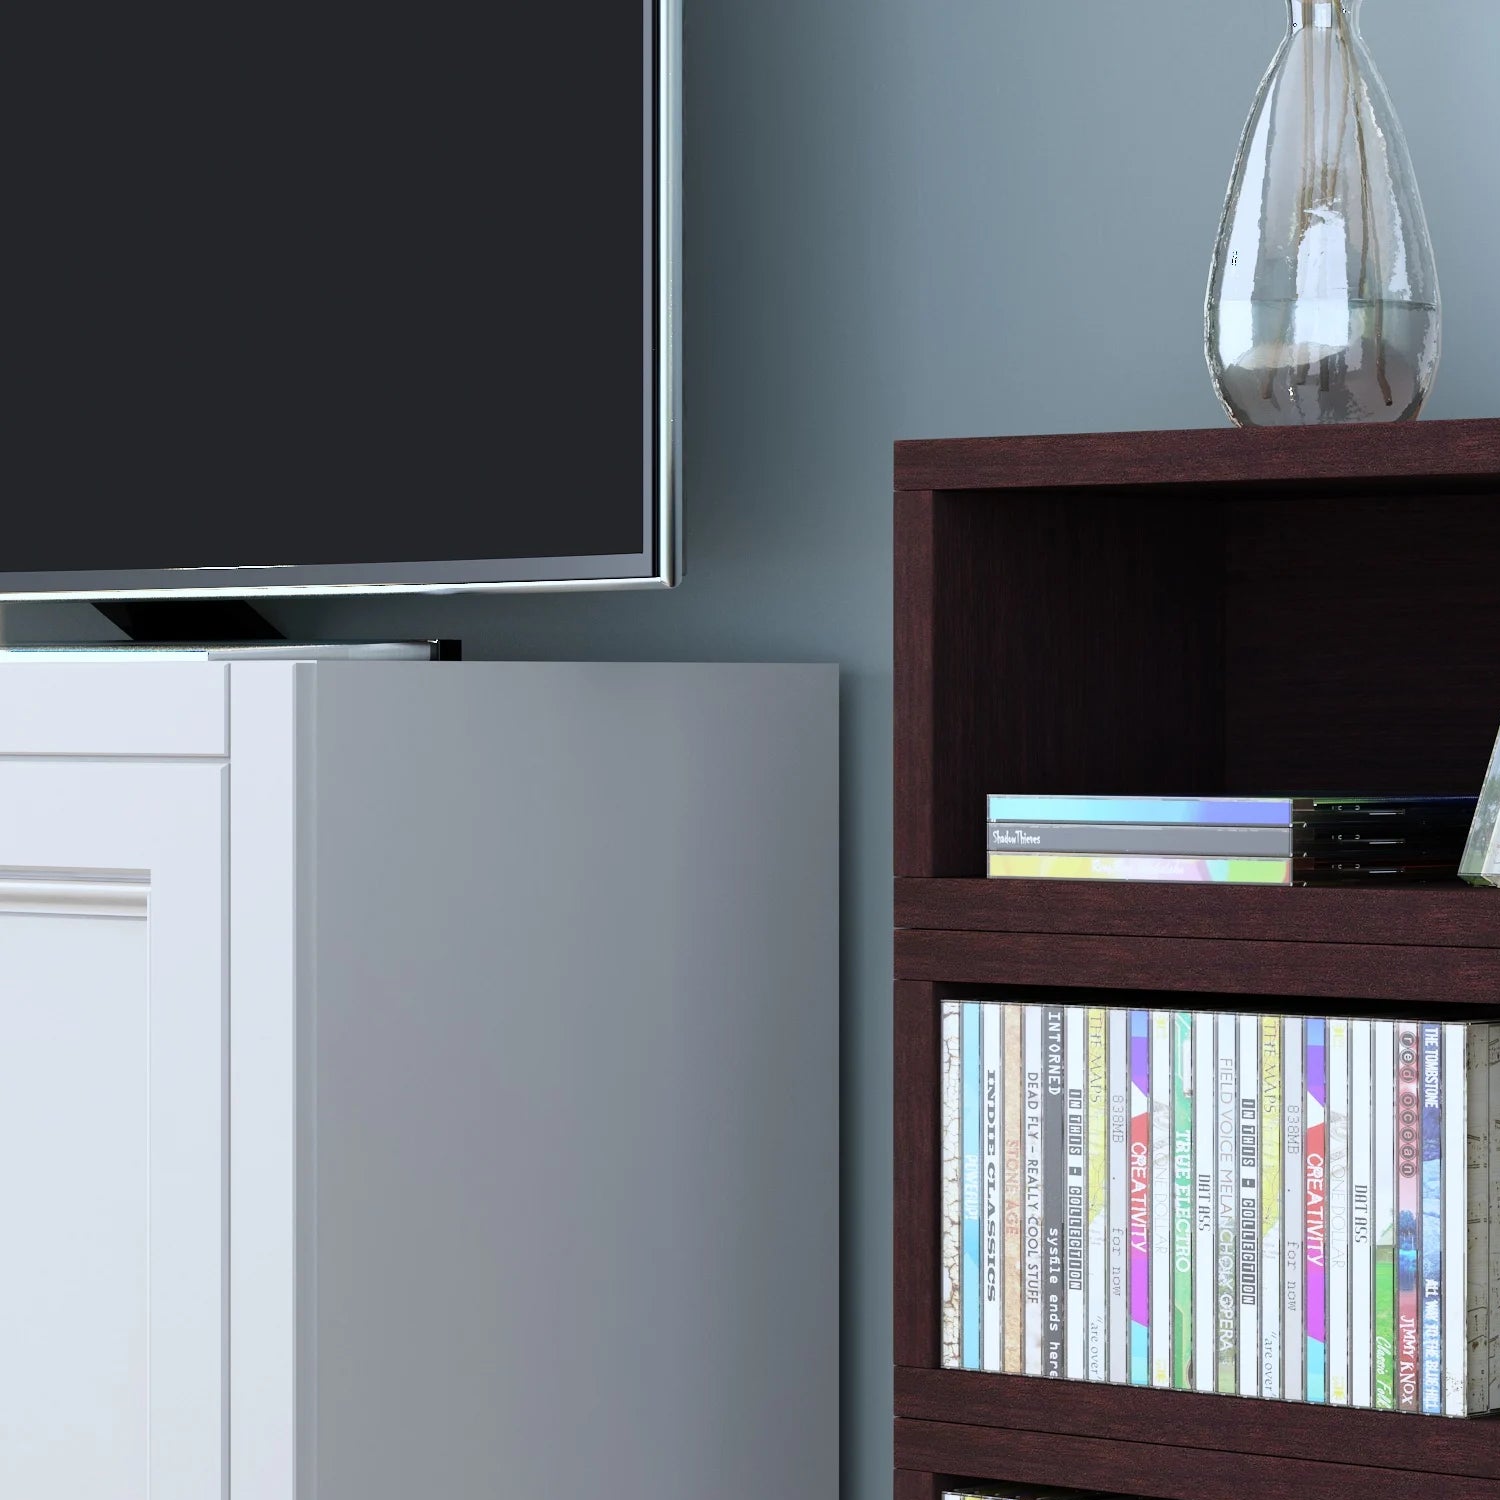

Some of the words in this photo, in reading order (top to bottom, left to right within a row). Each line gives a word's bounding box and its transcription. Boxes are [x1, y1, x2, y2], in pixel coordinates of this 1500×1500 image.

[1048, 1011, 1060, 1095] INTORNED
[1027, 1072, 1038, 1112] DEAD
[1069, 1089, 1081, 1108] IN
[1220, 1058, 1233, 1104] FIELD
[1424, 1050, 1438, 1108] TOMBSTONE
[987, 1070, 996, 1156] INDIE
[1027, 1116, 1038, 1138] FLY
[1242, 1099, 1255, 1119] IN
[1069, 1115, 1081, 1155] THIS
[1176, 1130, 1190, 1179] TRUE
[1220, 1110, 1233, 1162] VOICE
[1242, 1125, 1255, 1167] THIS
[1401, 1092, 1416, 1178] ocean
[1027, 1159, 1038, 1210] REALLY
[1131, 1142, 1146, 1253] CREATIVITY
[987, 1162, 996, 1302] CLASSICS
[1027, 1216, 1038, 1257] COOL
[1069, 1186, 1081, 1290] COLLECTION
[1112, 1227, 1124, 1255] for
[1176, 1184, 1190, 1272] ELECTRO
[1242, 1198, 1255, 1305] COLLECTION
[1048, 1228, 1061, 1284] sysfile
[1027, 1264, 1038, 1304] STUFF
[1112, 1267, 1124, 1296] now
[1048, 1294, 1061, 1331] ends
